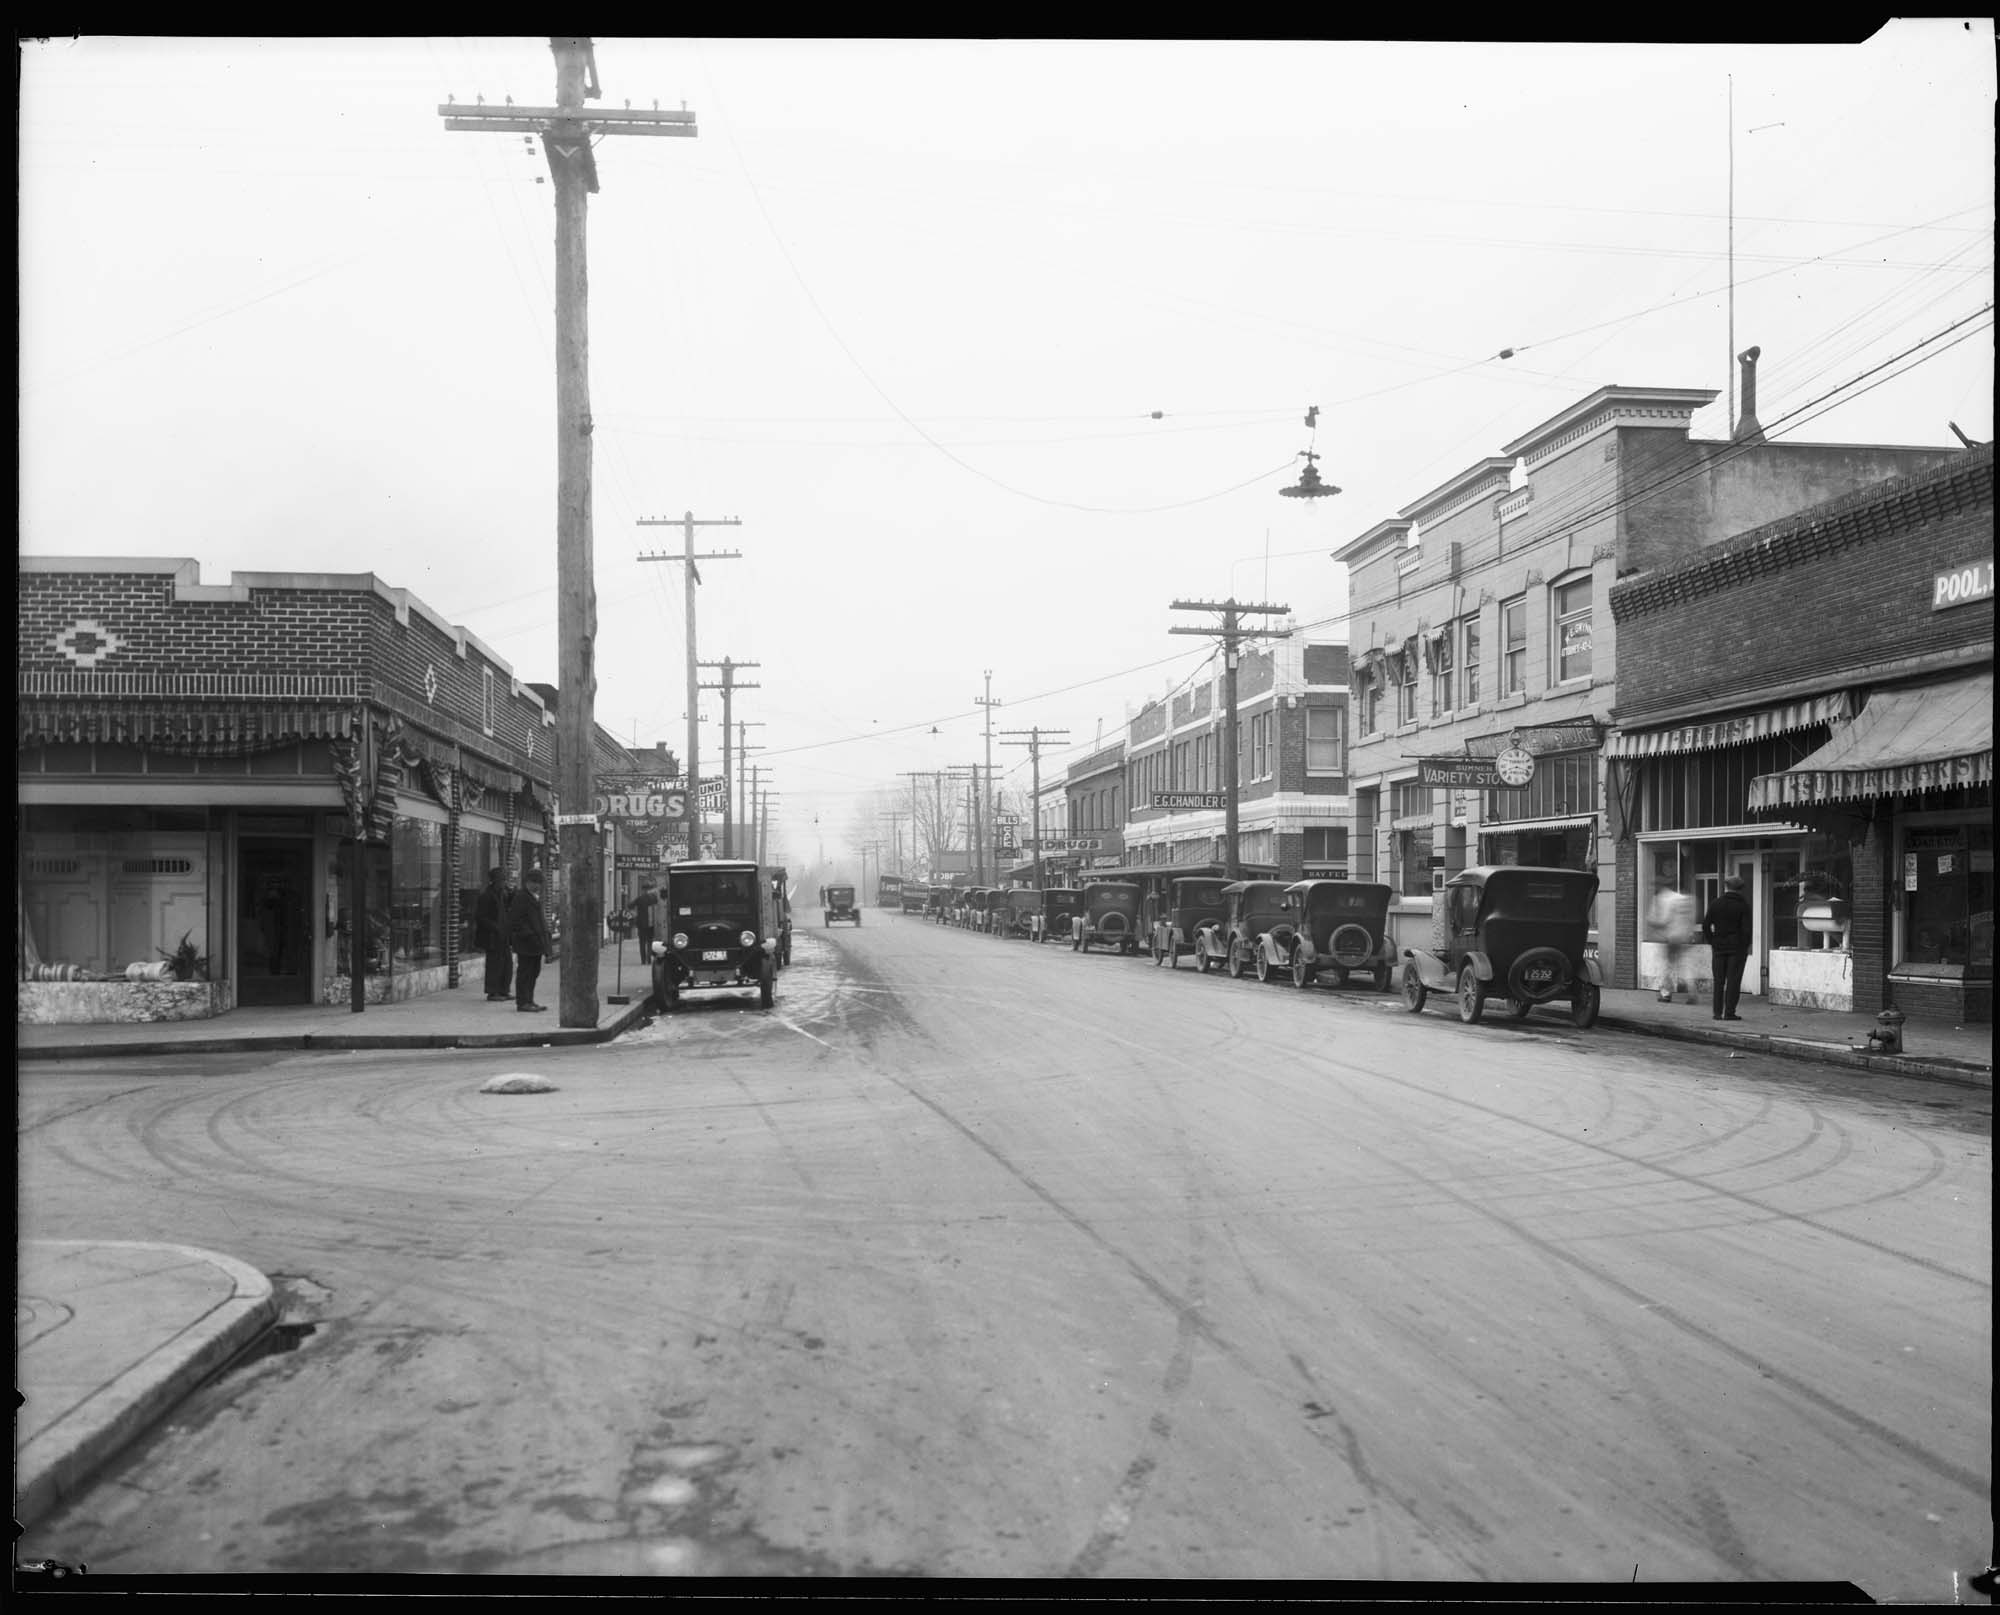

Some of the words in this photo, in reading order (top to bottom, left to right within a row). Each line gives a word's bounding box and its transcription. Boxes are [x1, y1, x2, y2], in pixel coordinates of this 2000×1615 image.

[1423, 767, 1472, 784] VARIETY
[1476, 771, 1504, 785] STO
[593, 794, 685, 817] DRUGS
[997, 816, 1019, 825] BILLS
[1045, 839, 1099, 850] DRUGS
